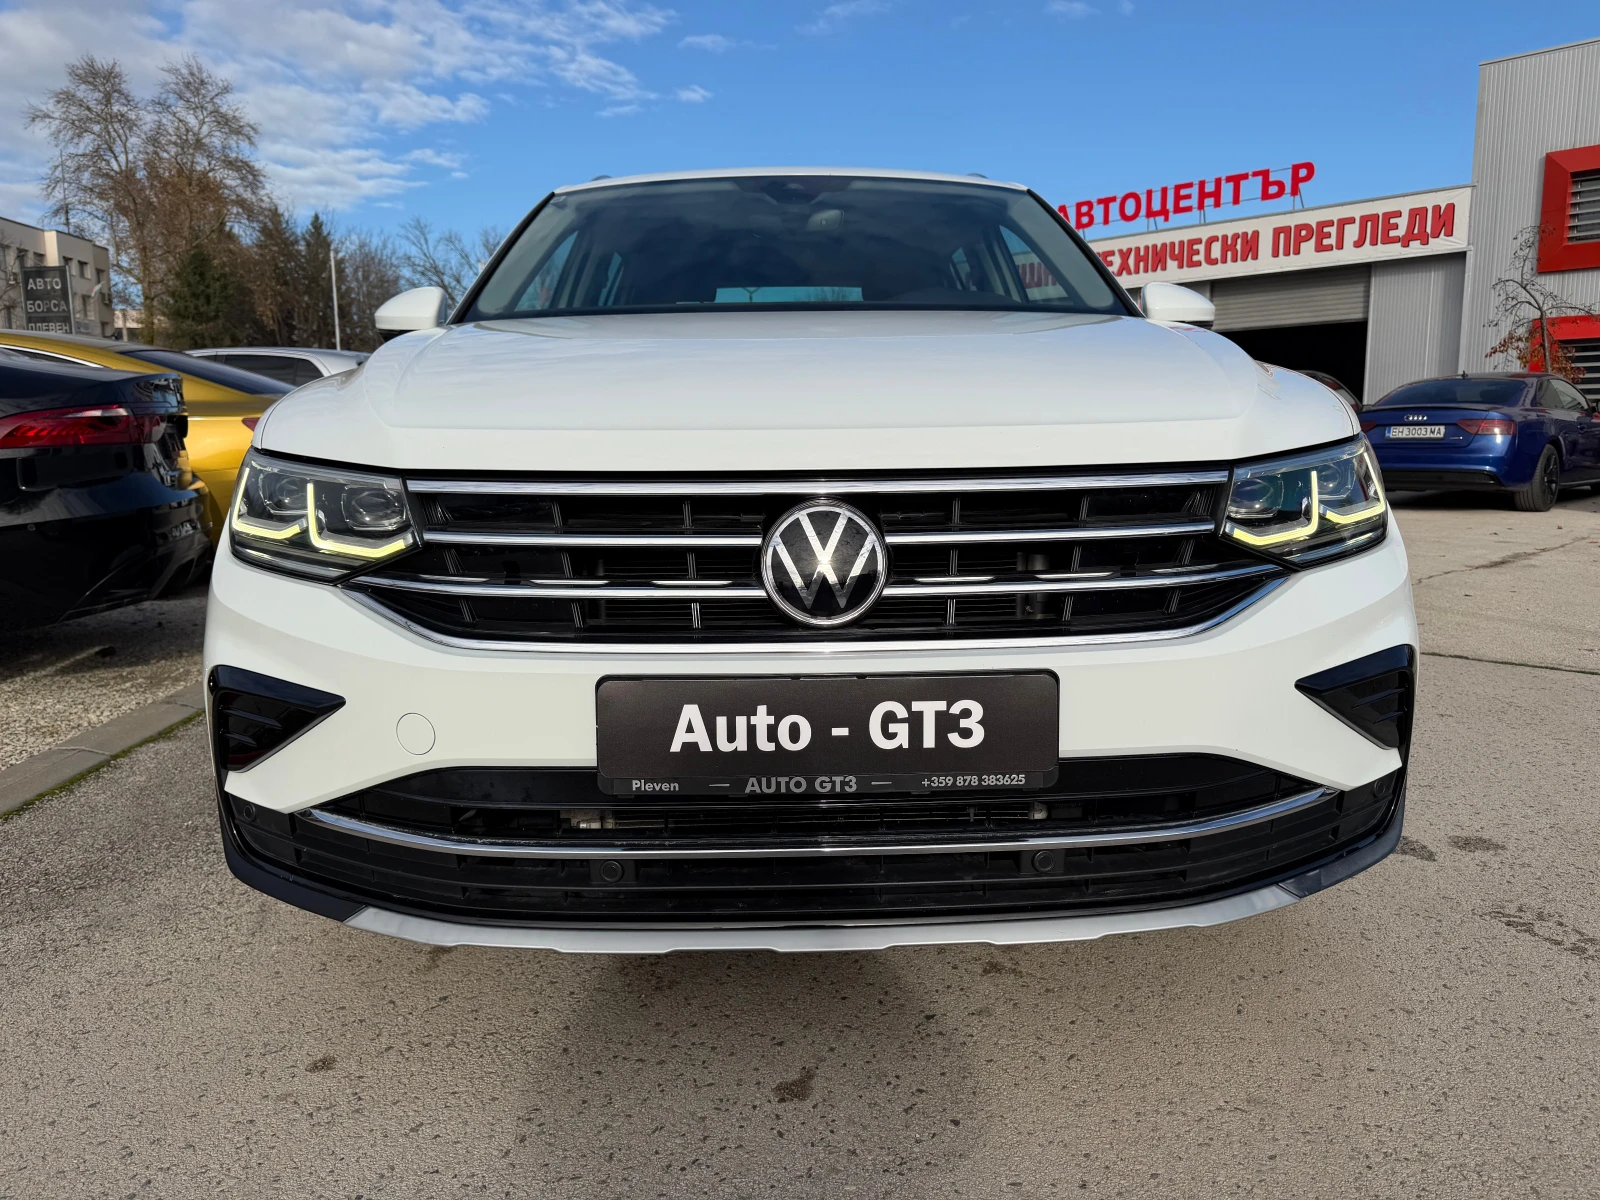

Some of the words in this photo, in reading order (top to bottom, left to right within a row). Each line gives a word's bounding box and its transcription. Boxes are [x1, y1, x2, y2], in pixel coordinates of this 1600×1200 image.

[1097, 230, 1259, 277] ЕХНИЧЕСКИ
[1272, 202, 1455, 258] ПРЕГЛЕДИ
[27, 278, 62, 290] АВТО
[26, 300, 68, 312] БОРСА
[1391, 427, 1404, 437] EH
[1405, 427, 1428, 437] 3003
[669, 703, 812, 753] Auto
[868, 699, 985, 750] GT3
[632, 779, 679, 792] Pleven
[745, 777, 806, 793] AUTO
[814, 776, 857, 793] GT3
[921, 775, 953, 787] +359
[956, 775, 978, 786] 878
[981, 774, 1026, 785] 383625
